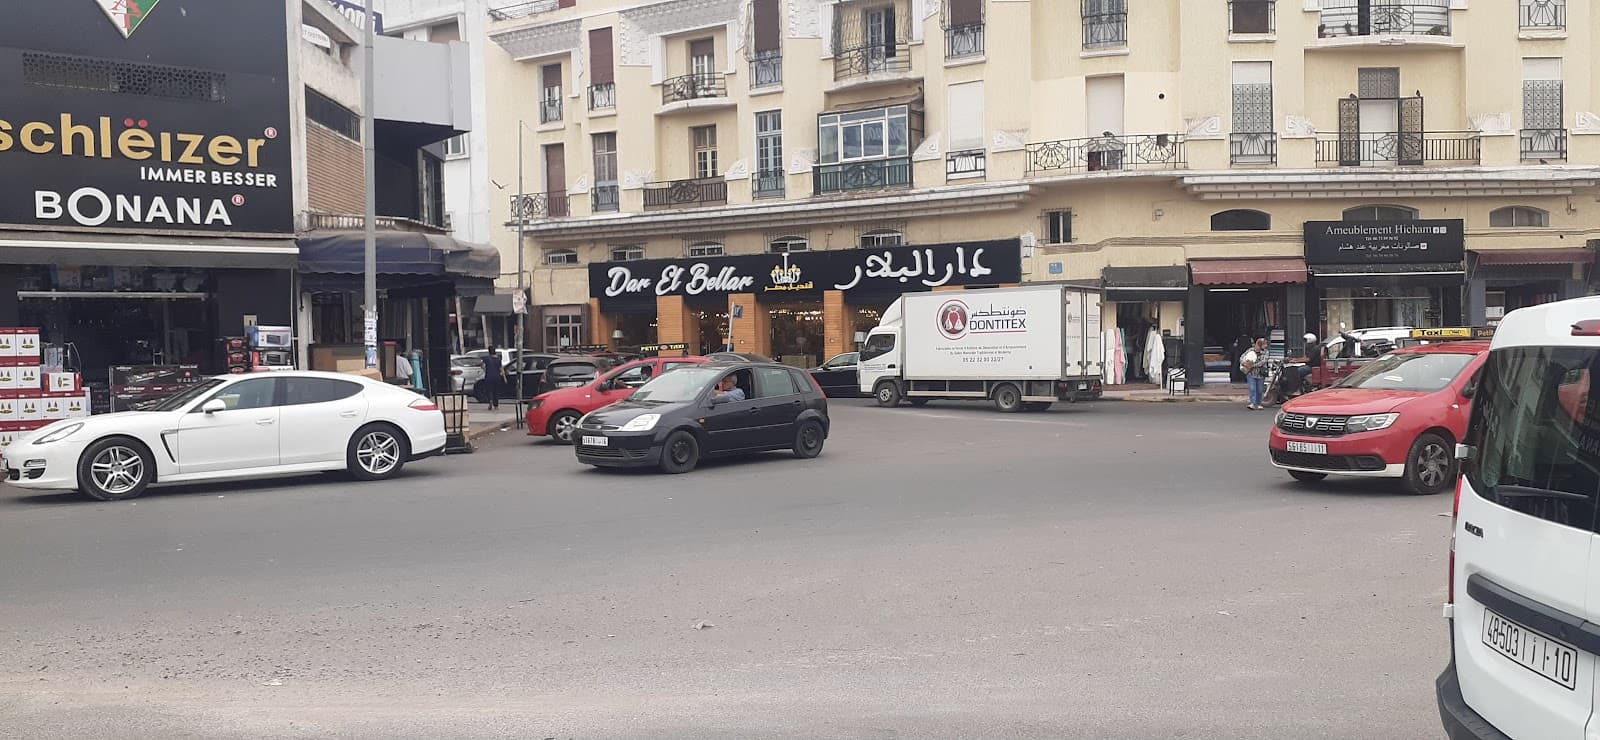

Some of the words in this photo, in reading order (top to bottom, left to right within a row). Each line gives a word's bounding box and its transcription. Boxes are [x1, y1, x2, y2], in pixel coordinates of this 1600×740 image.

[140, 166, 207, 184] IMMER
[211, 171, 277, 187] BESSER
[35, 187, 232, 226] BONANA
[1325, 224, 1392, 235] Ameublement
[1395, 224, 1432, 234] Hicham
[605, 266, 652, 297] Dar
[655, 264, 685, 296] El
[685, 263, 754, 295] Bellar
[922, 246, 992, 287] دار
[970, 318, 1026, 331] DONTITEX
[1555, 648, 1571, 683] 10
